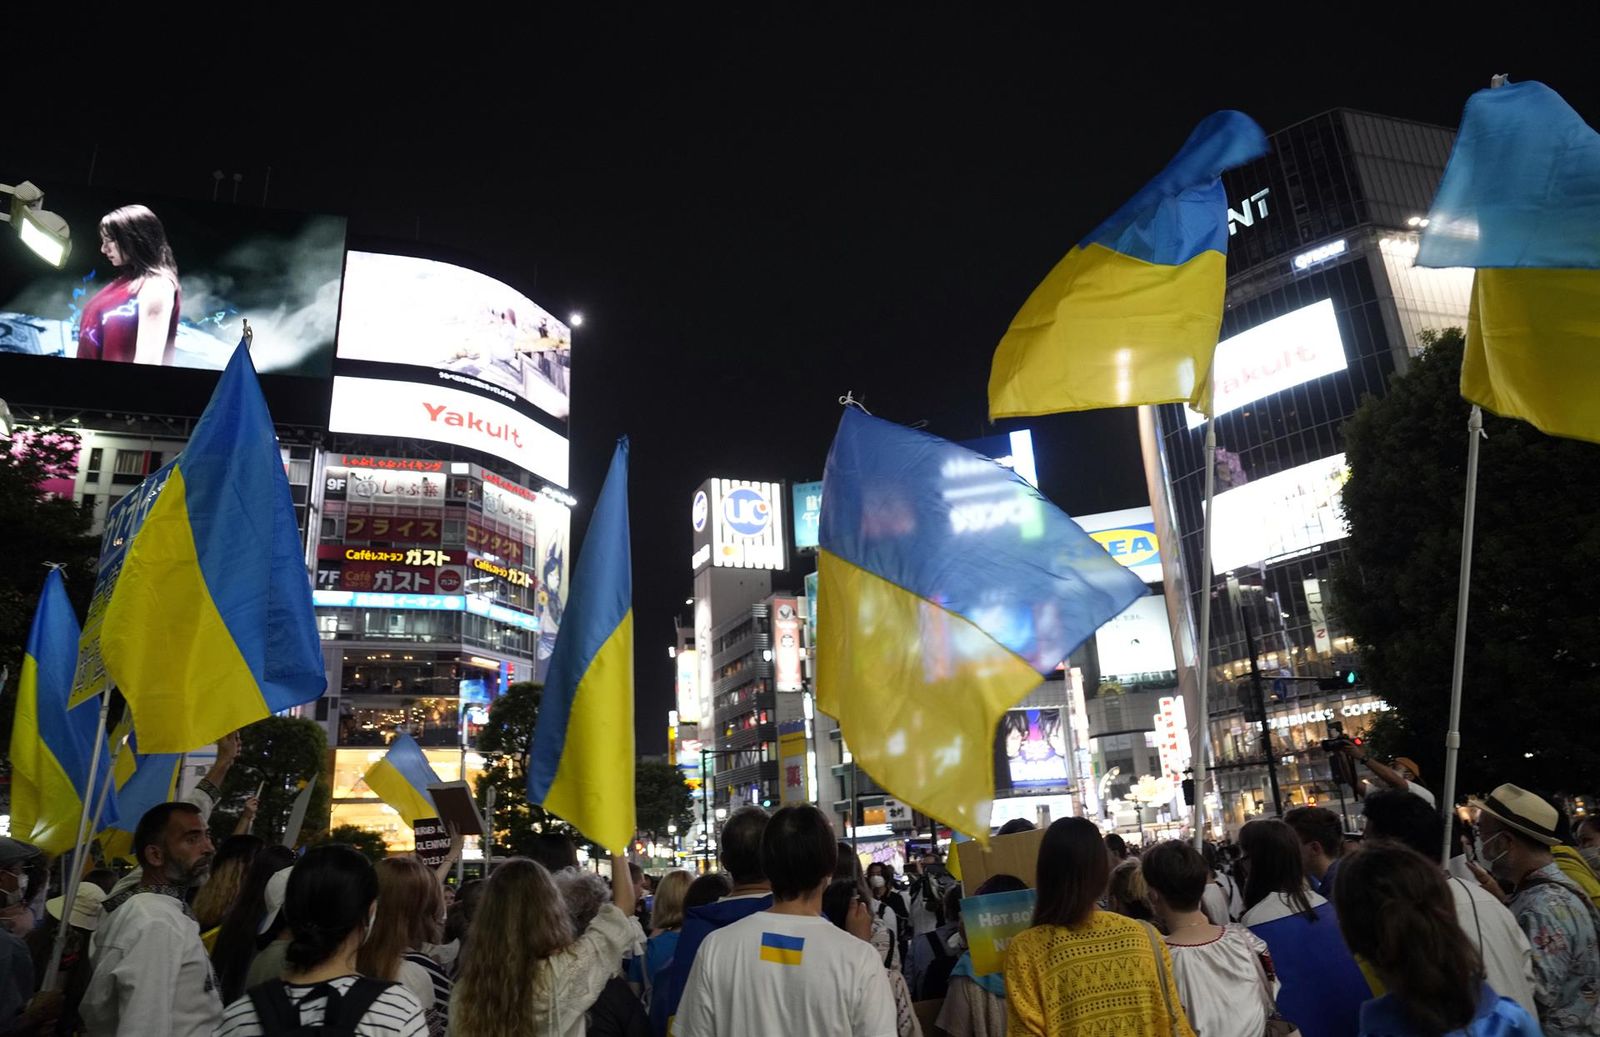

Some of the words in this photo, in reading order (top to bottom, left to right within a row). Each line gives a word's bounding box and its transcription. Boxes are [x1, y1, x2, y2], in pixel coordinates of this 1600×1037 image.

[1227, 187, 1270, 237] NT
[1212, 345, 1317, 396] akult
[422, 402, 523, 449] Yakult
[326, 478, 346, 491] 9F
[467, 525, 521, 558] コンタクト
[1108, 537, 1153, 556] EA
[405, 549, 451, 567] ガスト
[318, 570, 340, 584] 7F
[373, 570, 430, 591] ガスト
[508, 567, 534, 588] ガスト
[978, 912, 1009, 927] Нет
